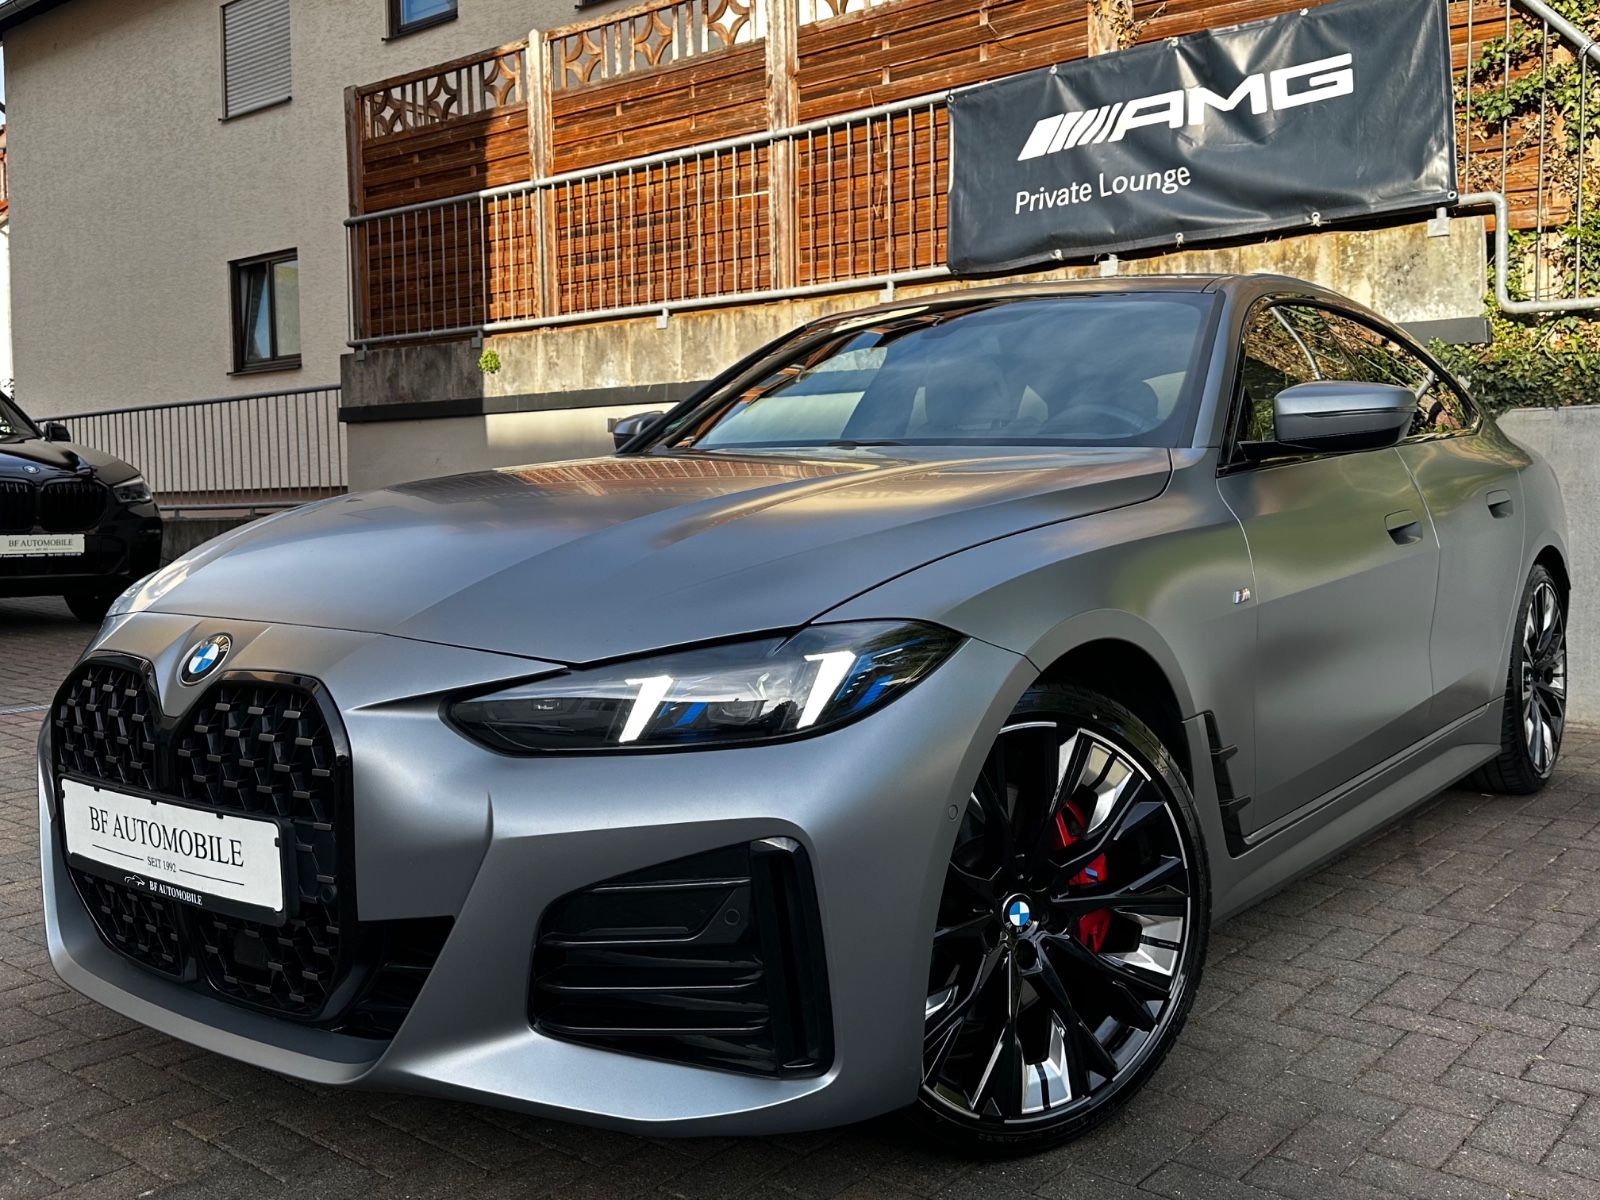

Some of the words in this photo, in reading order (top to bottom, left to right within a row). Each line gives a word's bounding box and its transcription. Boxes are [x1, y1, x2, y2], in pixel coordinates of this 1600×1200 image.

[1108, 53, 1354, 142] AMG
[1015, 181, 1092, 214] Private
[1099, 165, 1191, 197] Lounge
[21, 539, 73, 547] AUTOMOBILE
[88, 805, 108, 833] BF
[113, 813, 245, 867] AUTOMOBILE
[147, 856, 161, 869] SEIT
[163, 861, 177, 873] 1992
[149, 880, 158, 892] BF
[159, 884, 203, 905] AUTOMOBILE
